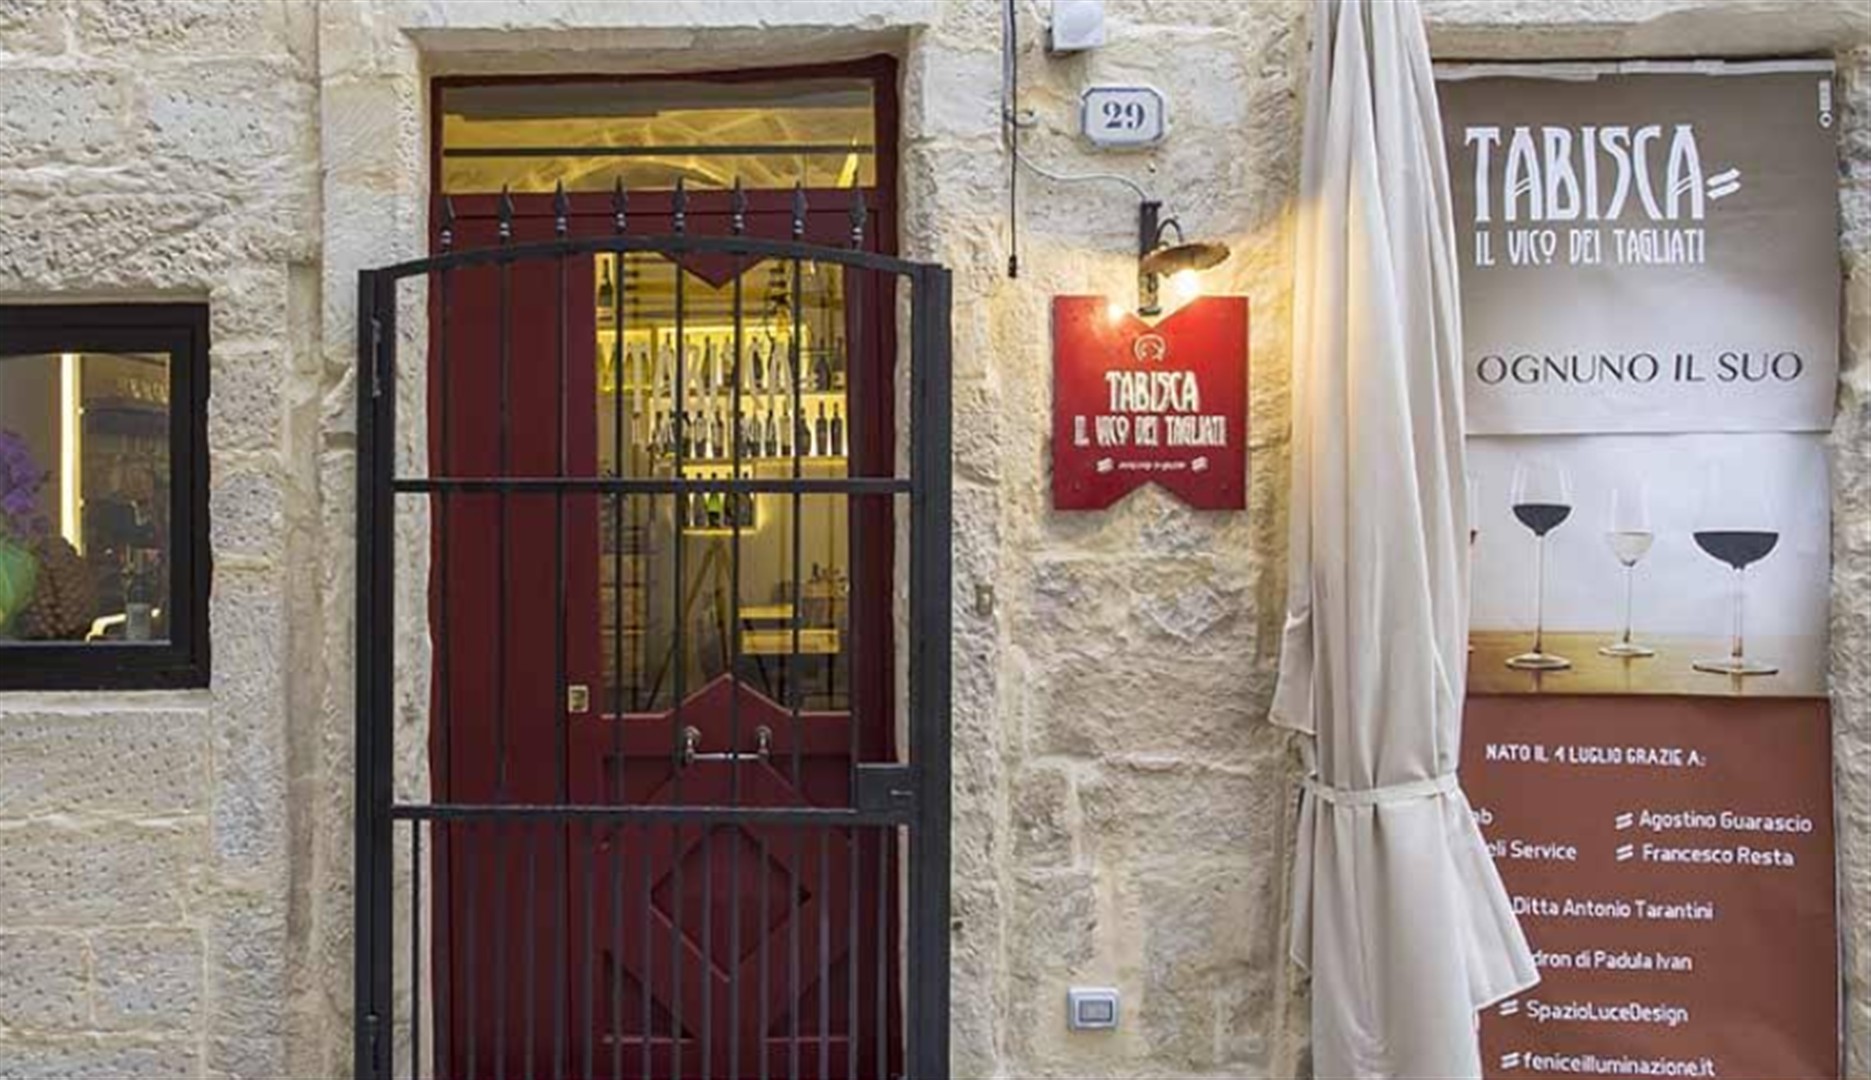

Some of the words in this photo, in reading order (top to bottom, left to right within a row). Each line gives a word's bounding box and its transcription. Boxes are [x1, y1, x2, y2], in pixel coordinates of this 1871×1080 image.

[1103, 102, 1145, 129] 29
[1465, 124, 1705, 223] TABISCA
[1475, 230, 1496, 267] IL
[1507, 229, 1557, 266] VICO
[1569, 229, 1600, 266] DEI
[1613, 228, 1706, 266] TAGLIATI
[1475, 354, 1660, 386] OGNUNO
[1674, 353, 1706, 382] IL
[1716, 351, 1805, 383] SUO
[1104, 369, 1201, 414] TABISCA
[1074, 415, 1090, 447] IL
[1095, 415, 1130, 447] VICO
[1134, 415, 1159, 447] DEI
[1164, 415, 1228, 447] TAGLIATI
[1485, 743, 1531, 762] NATO
[1534, 745, 1549, 763] IL
[1568, 745, 1623, 765] LUGLIO
[1625, 746, 1683, 767] GRAZIE
[1639, 809, 1717, 832] Agostino
[1720, 810, 1813, 833] Guarascio
[1510, 839, 1578, 861] Service
[1642, 842, 1734, 865] Francesco
[1737, 846, 1795, 867] Resta
[1512, 895, 1560, 916] Ditta
[1562, 897, 1632, 918] Antonio
[1635, 899, 1714, 920] Tarantini
[1575, 949, 1591, 969] di
[1594, 950, 1653, 971] Padula
[1656, 951, 1694, 971] Ivan
[1526, 998, 1690, 1028] SpazioLuceDesign
[1522, 1050, 1716, 1078] feniceilluminazione.it
